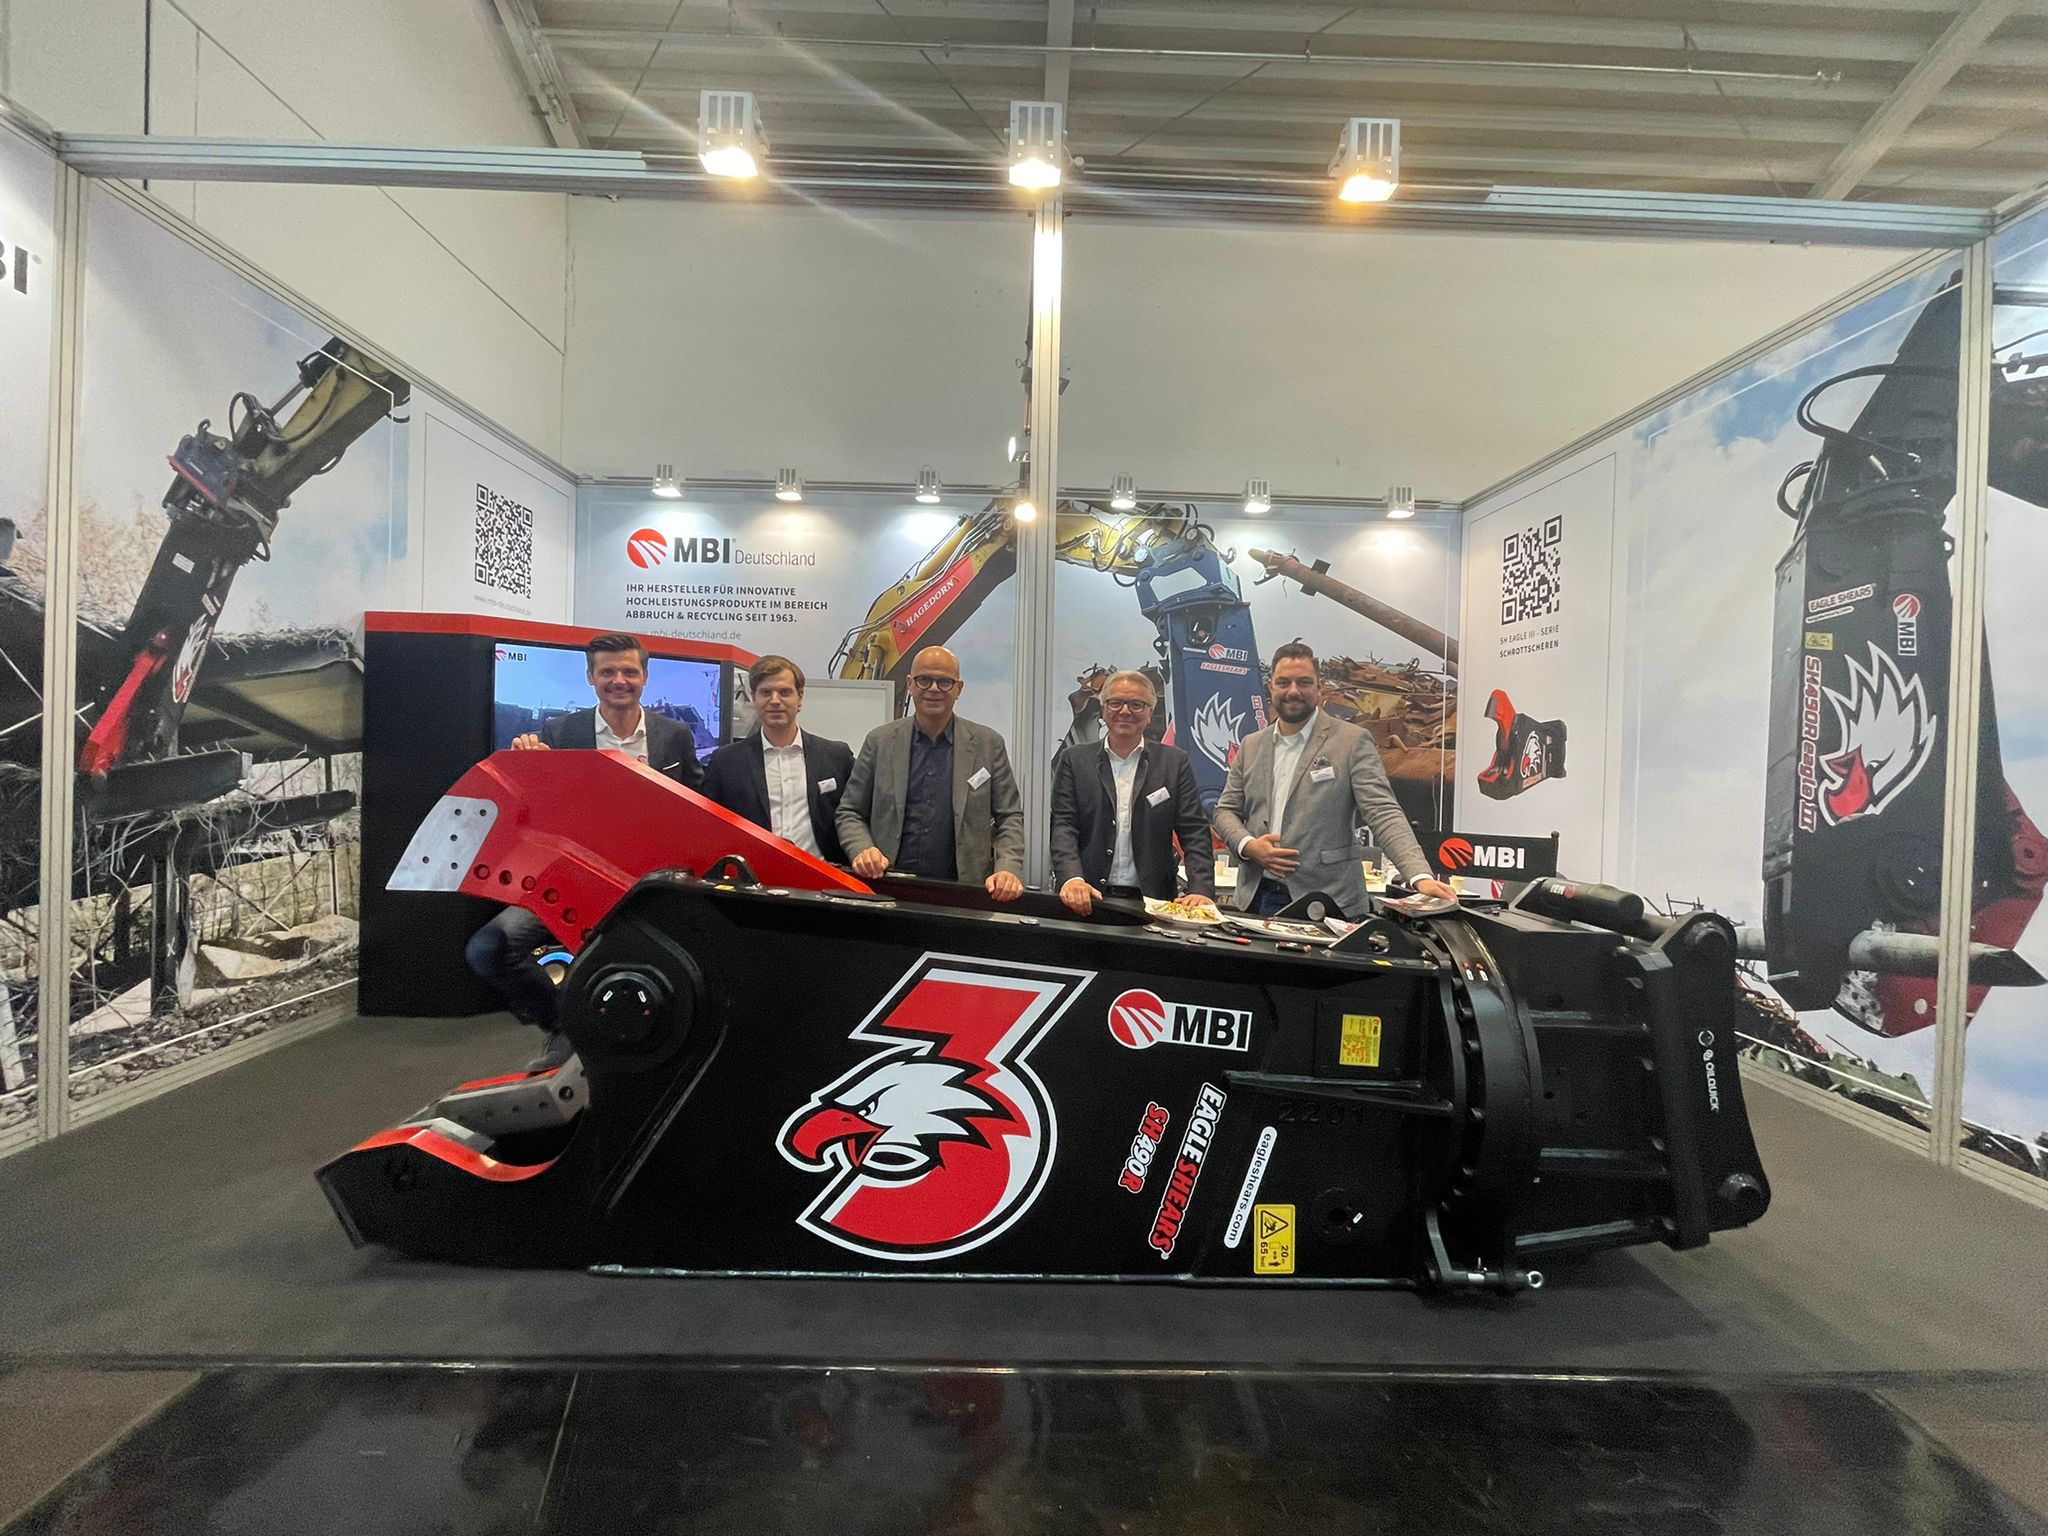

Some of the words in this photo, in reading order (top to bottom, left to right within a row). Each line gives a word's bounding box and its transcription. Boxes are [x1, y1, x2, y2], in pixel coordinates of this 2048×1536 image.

[674, 537, 730, 564] MBI
[735, 550, 816, 567] Deutschland
[626, 584, 644, 593] IHR
[647, 584, 711, 594] HERSTELLER
[713, 584, 734, 595] FÜR
[736, 586, 796, 596] INNOVATIVE
[905, 578, 955, 627] HAGEDORN
[1810, 596, 1837, 611] EAGLE
[1837, 586, 1872, 604] SHEARS
[626, 597, 767, 609] HOCHLEISTUNGSPRODUKTE
[770, 600, 781, 609] IM
[784, 601, 828, 610] BEREICH
[625, 610, 675, 620] ABBRUCH
[677, 612, 684, 620] &
[687, 611, 743, 622] RECYCLING
[745, 613, 767, 622] SEIT
[770, 613, 797, 623] 1963.
[1509, 631, 1527, 643] EAGLE
[1541, 624, 1559, 636] SERIE
[1899, 621, 1915, 655] MBI
[508, 652, 527, 661] MBI
[1226, 649, 1247, 661] MBI
[1500, 640, 1559, 658] SCHROTTSCHEREN
[1799, 742, 1816, 799] eagle
[1473, 845, 1525, 869] MBI
[1172, 1006, 1249, 1049] MBI
[1705, 1062, 1720, 1112] OILQUICK
[1182, 1086, 1224, 1164] EAGLE
[1119, 1103, 1170, 1192] SH490R
[1228, 1133, 1272, 1241] eagleshears.com
[1151, 1157, 1199, 1253] SHEARS
[1260, 1241, 1269, 1255] 65
[1281, 1245, 1289, 1258] 20
